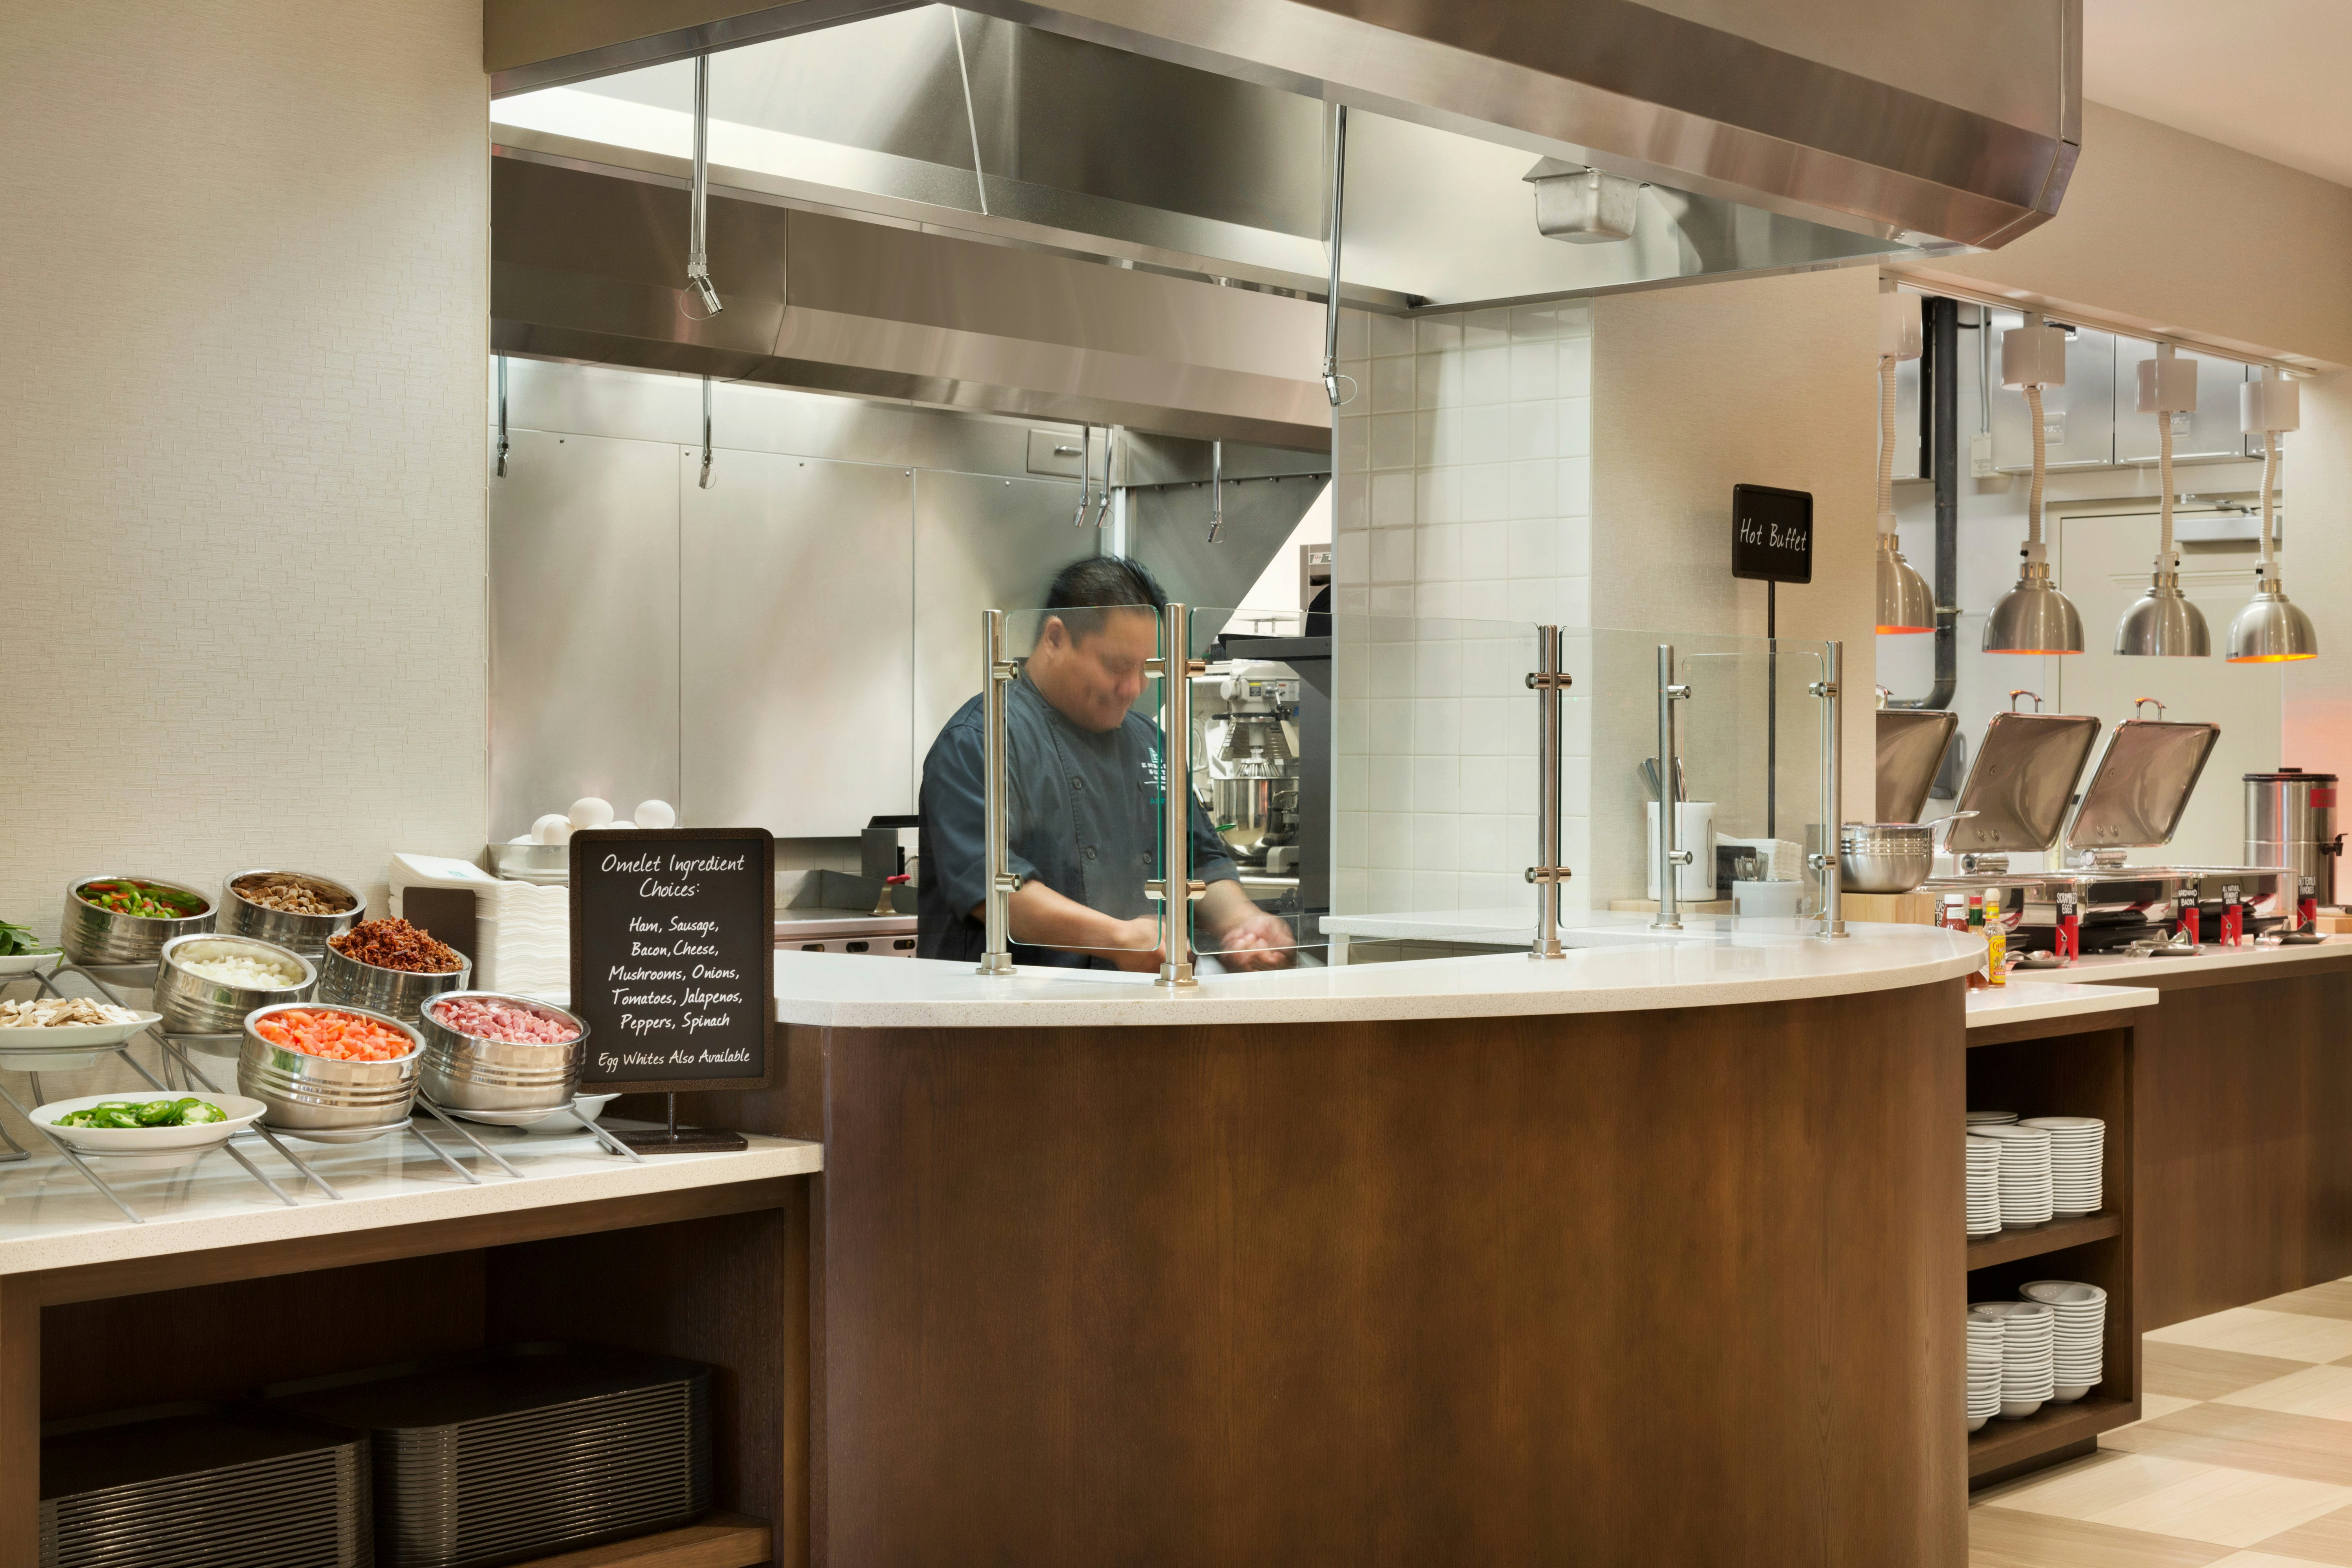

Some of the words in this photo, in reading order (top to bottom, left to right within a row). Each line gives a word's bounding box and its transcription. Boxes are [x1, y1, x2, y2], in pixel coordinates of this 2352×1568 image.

[1740, 517, 1762, 545] Hot
[1769, 523, 1806, 551] Buffet
[601, 853, 661, 873] Omelet
[669, 854, 745, 881] Ingredient
[639, 877, 700, 898] Choices:
[2056, 892, 2078, 904] SCRAMBLED
[2178, 889, 2198, 897] HARDWOOD
[2062, 903, 2073, 914] EGGS
[2181, 898, 2195, 907] BACON
[629, 916, 662, 934] Ham,
[668, 916, 719, 938] Sausage,
[631, 942, 671, 958] Bacon,
[673, 940, 719, 956] Cheese,
[608, 965, 686, 982] Mushrooms,
[691, 964, 740, 980] Onions,
[612, 988, 677, 1006] Tomatoes,
[679, 987, 743, 1010] Jalapenos,
[621, 1013, 676, 1036] Peppers,
[681, 1012, 730, 1035] Spinach
[598, 1052, 619, 1073] Egg
[623, 1051, 665, 1065] Whites
[668, 1049, 695, 1064] Also
[698, 1047, 750, 1063] Available
